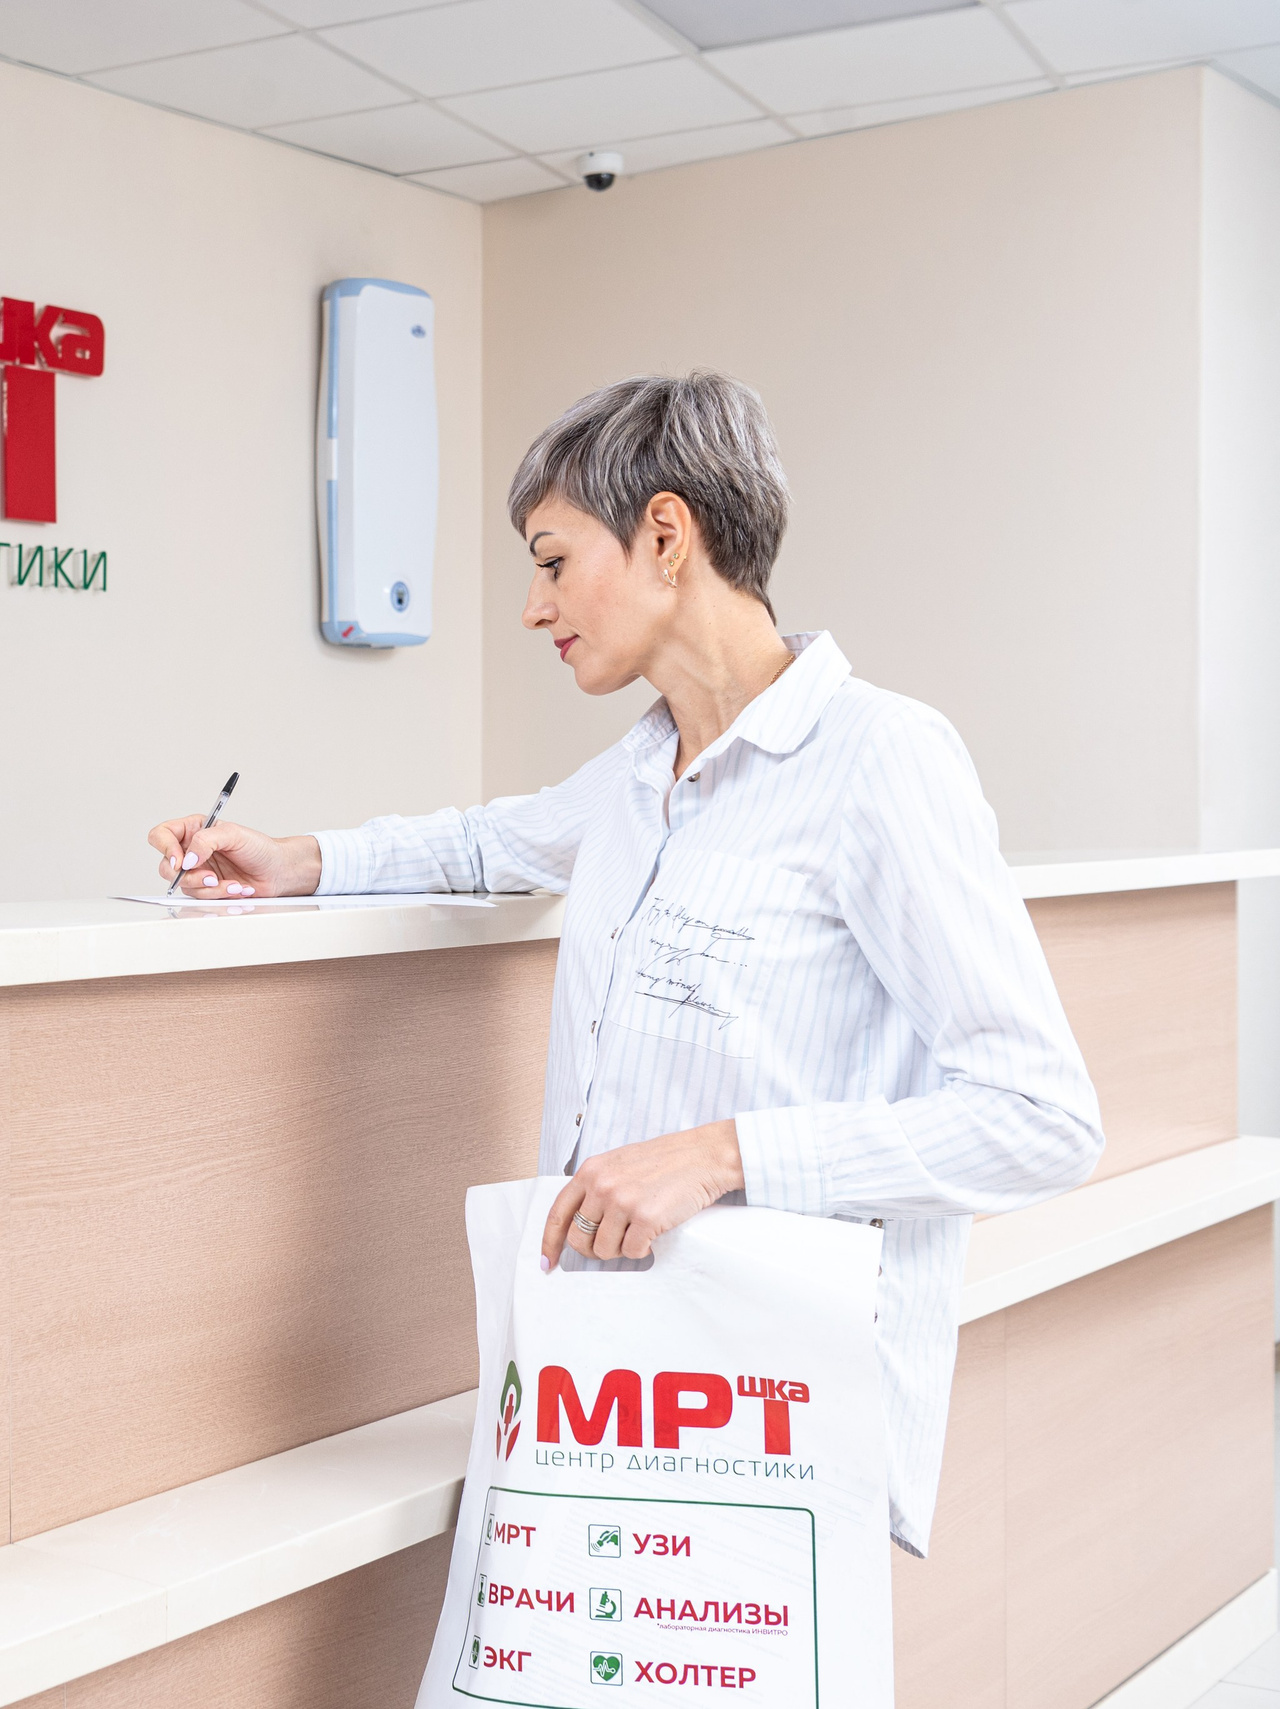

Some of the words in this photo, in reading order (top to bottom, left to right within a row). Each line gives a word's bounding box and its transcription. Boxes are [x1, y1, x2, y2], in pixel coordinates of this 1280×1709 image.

[536, 1365, 792, 1456] МРТ
[535, 1449, 614, 1473] центр
[626, 1453, 815, 1480] диагностики
[494, 1521, 537, 1547] МРТ
[632, 1533, 691, 1557] УЗИ
[488, 1582, 575, 1613] ВРАЧИ
[633, 1597, 789, 1627] АНАЛИЗЫ
[483, 1645, 532, 1672] ЭКГ
[634, 1660, 757, 1689] ХОЛТЕР
